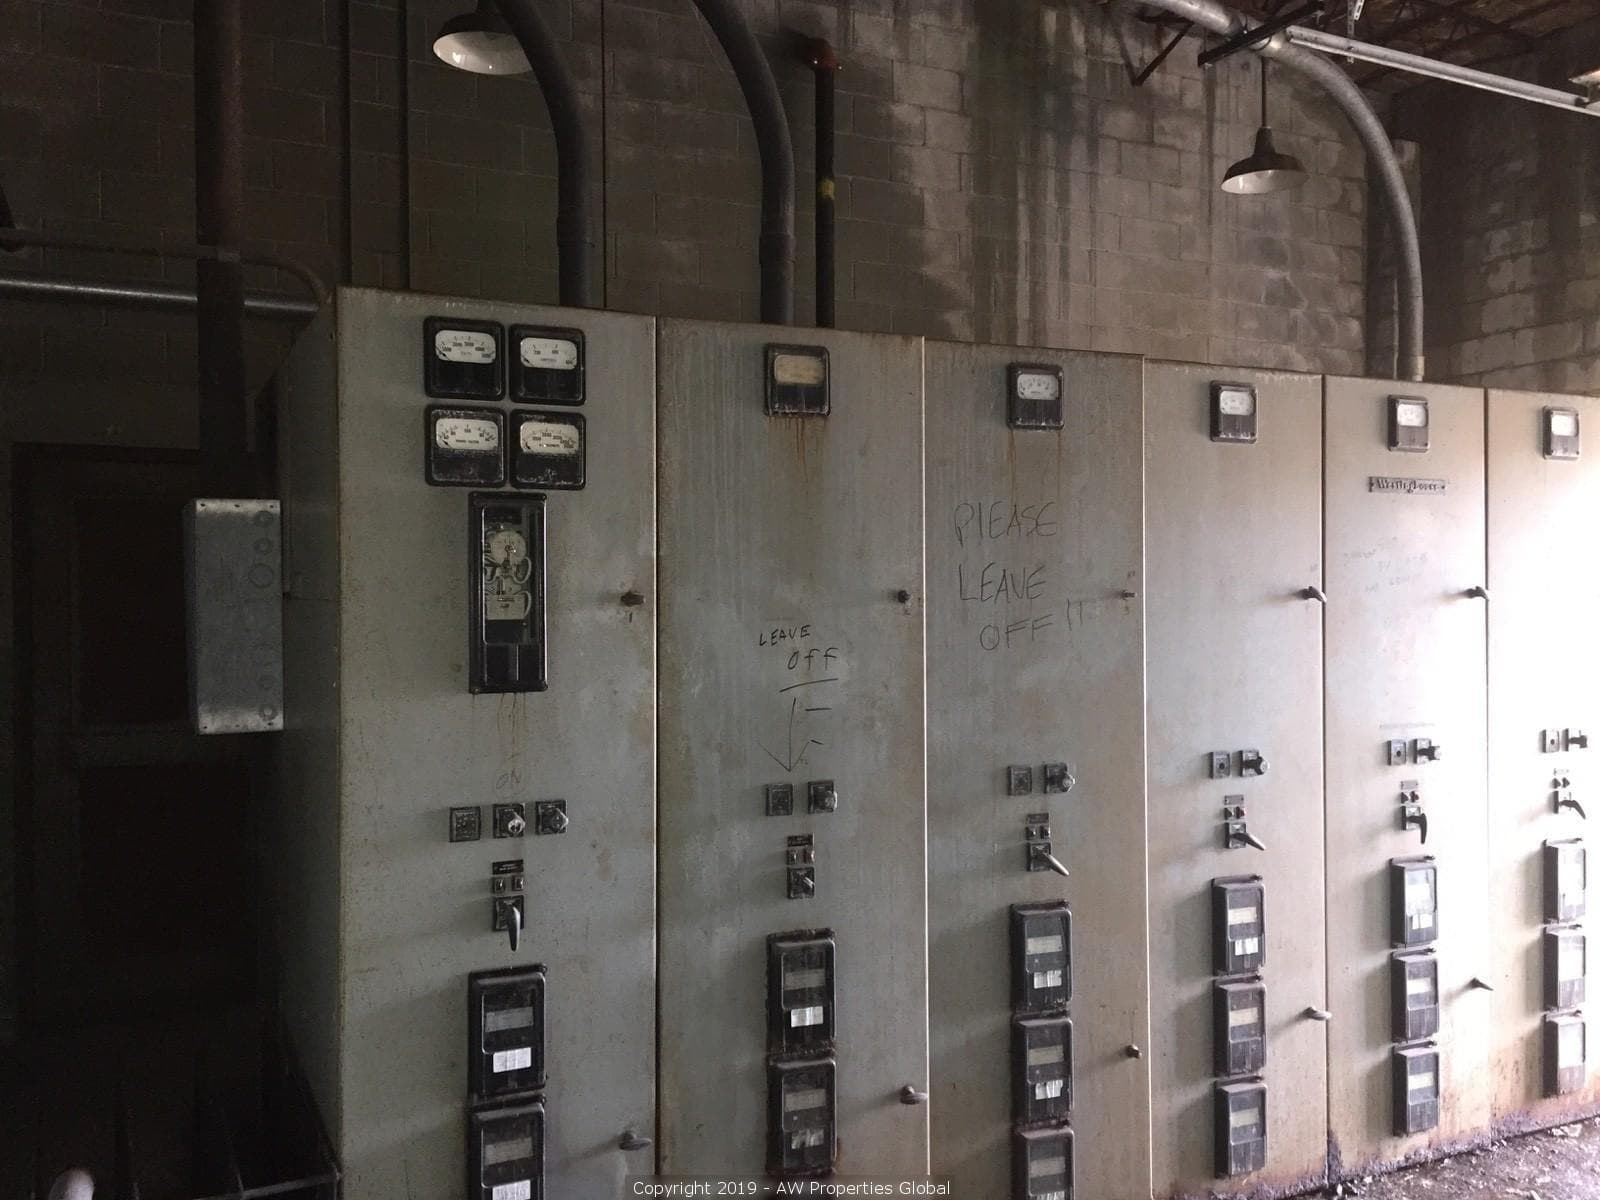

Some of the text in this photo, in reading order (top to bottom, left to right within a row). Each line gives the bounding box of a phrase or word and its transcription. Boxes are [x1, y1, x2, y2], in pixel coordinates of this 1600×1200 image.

[958, 562, 1046, 604] LEAVE
[759, 624, 811, 647] LEAVE
[980, 614, 1054, 651] OFF
